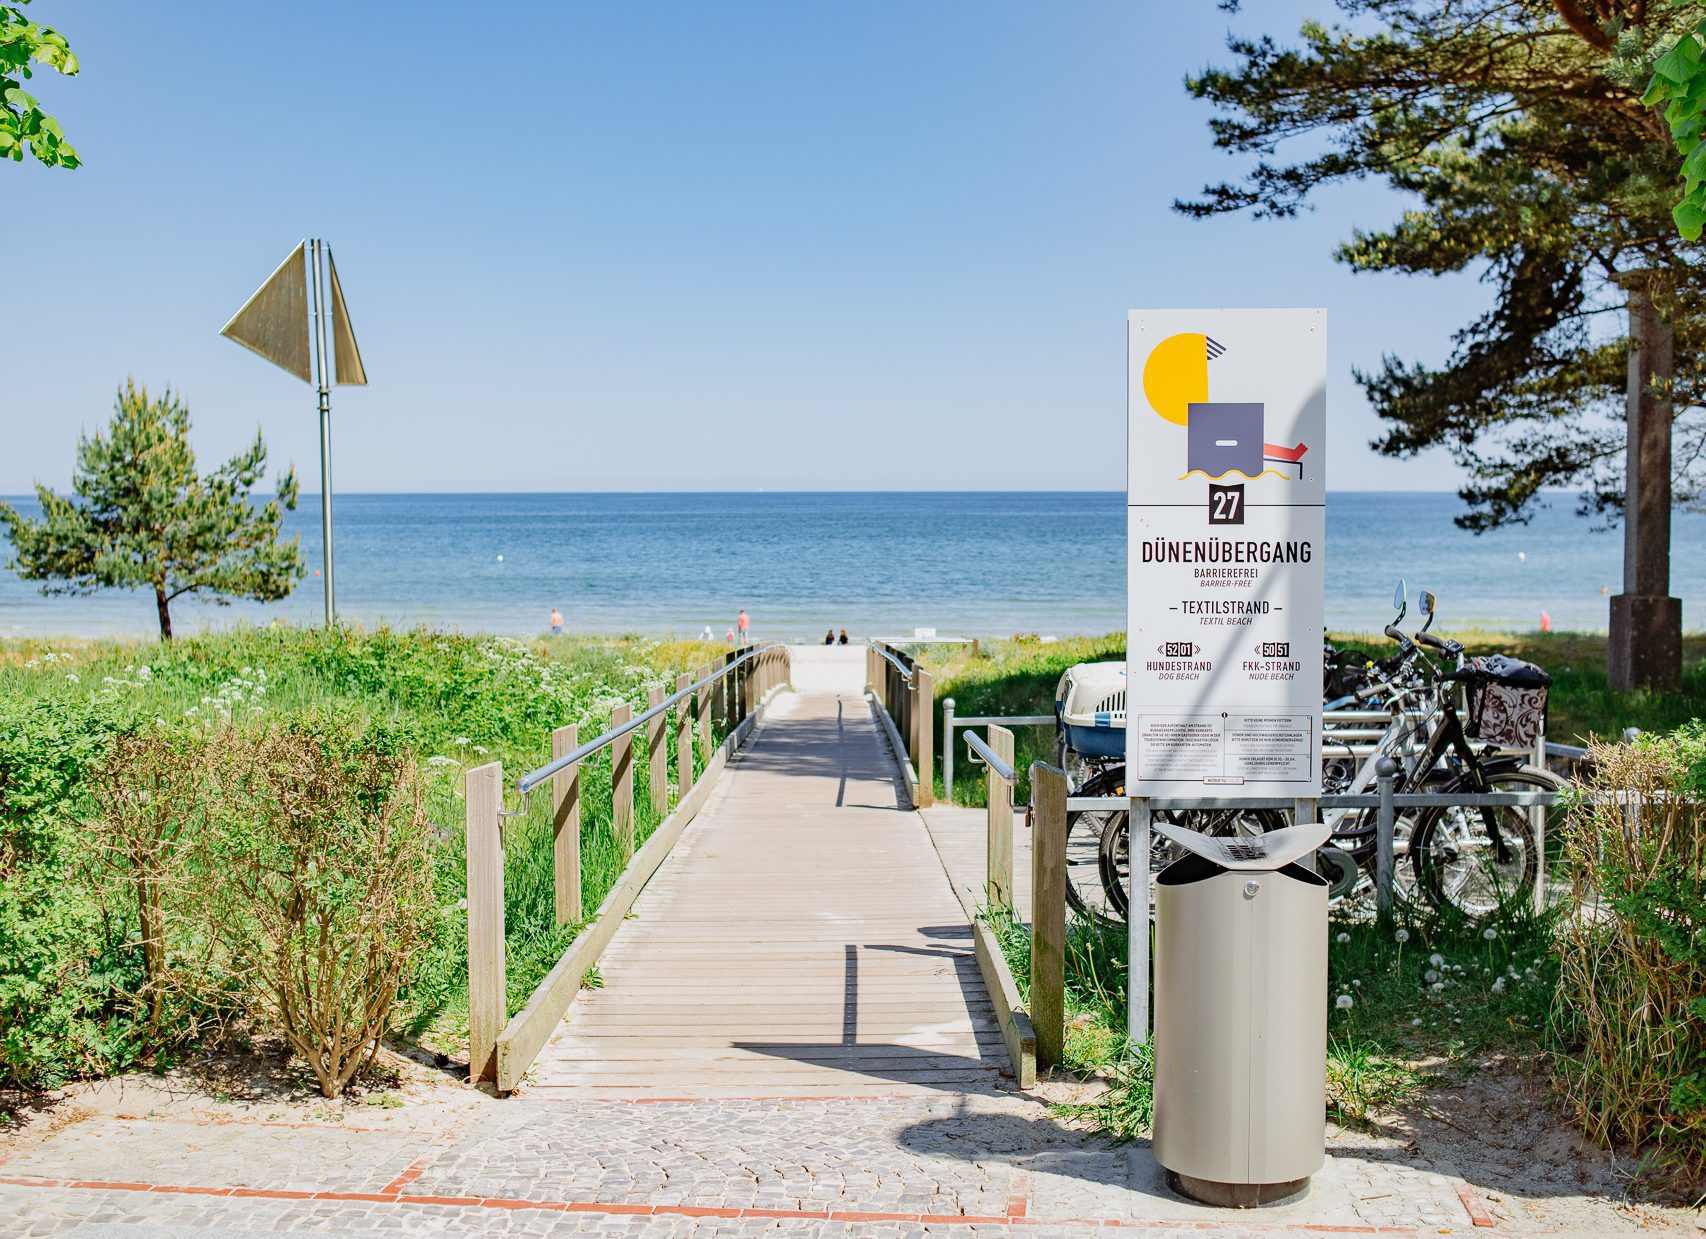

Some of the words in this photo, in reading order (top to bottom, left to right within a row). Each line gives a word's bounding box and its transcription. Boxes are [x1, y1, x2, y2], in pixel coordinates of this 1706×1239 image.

[1213, 491, 1240, 520] 27
[1142, 537, 1312, 563] DÜNENÜBERGANG
[1194, 568, 1258, 579] BARRIEREFREI
[1200, 579, 1252, 588] BARRIER-FREE
[1182, 600, 1270, 615] TEXTILSTRAND
[1199, 617, 1224, 626] TEXTIL
[1226, 617, 1253, 626] BEACH
[1166, 644, 1178, 656] 52
[1180, 644, 1192, 656] 01
[1263, 644, 1275, 656] 50
[1277, 644, 1289, 656] 51
[1146, 661, 1212, 671] HUNDESTRAND
[1242, 661, 1301, 671] FKK-STRAND
[1158, 673, 1174, 681] DOG
[1175, 673, 1200, 681] BEACH
[1248, 673, 1269, 681] NUDE
[1270, 672, 1295, 681] BEACH
